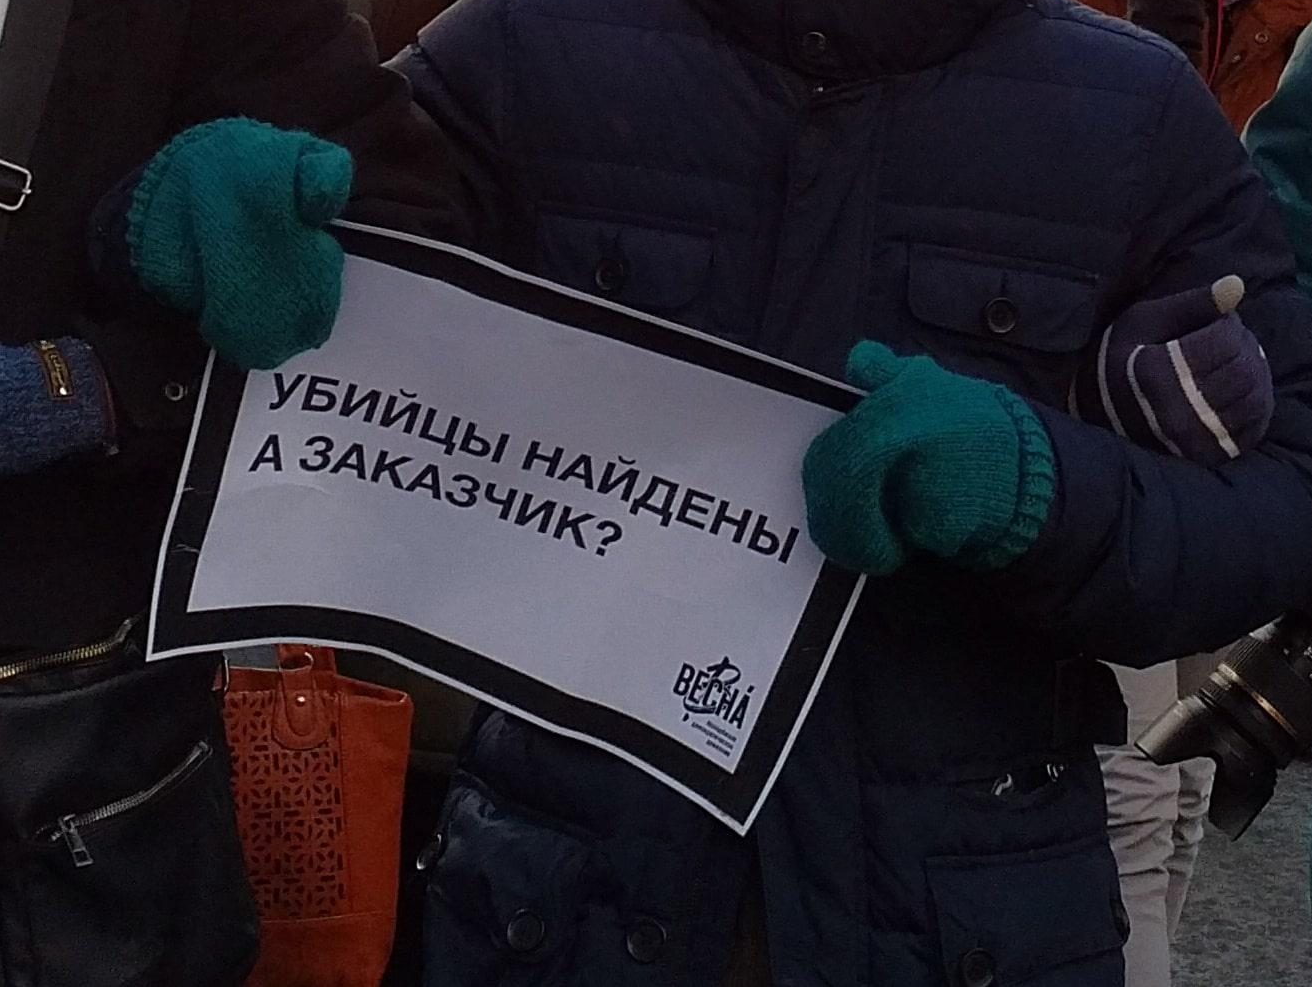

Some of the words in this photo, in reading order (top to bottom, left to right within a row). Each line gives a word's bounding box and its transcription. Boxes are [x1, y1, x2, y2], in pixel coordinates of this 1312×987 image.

[248, 434, 283, 473] А
[299, 435, 623, 557] ЗАКАЗЧИК?
[268, 372, 511, 464] УБИЙЦЫ
[521, 440, 800, 564] НАЙДЕНЫ
